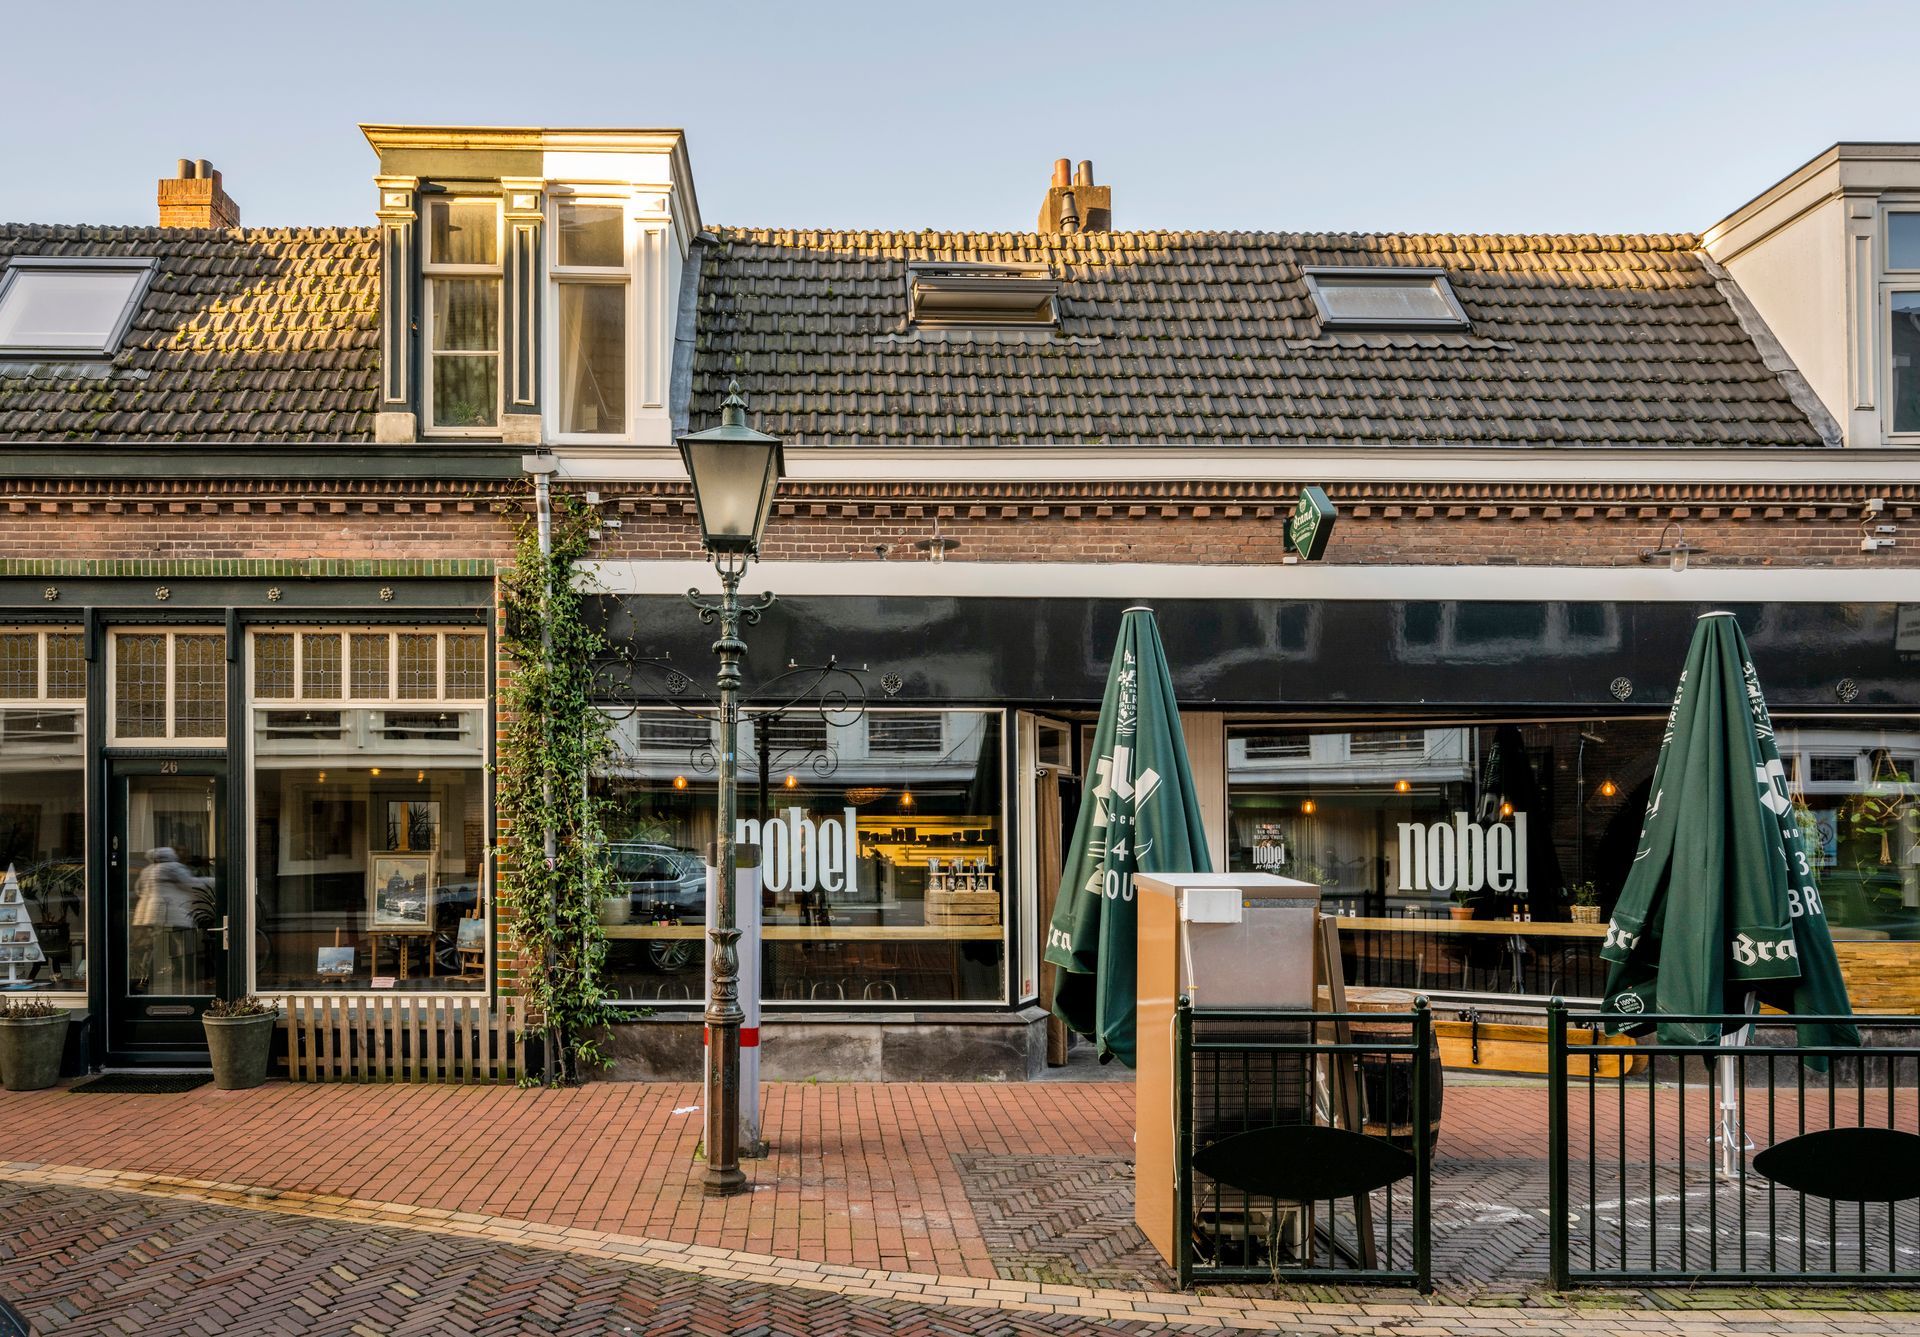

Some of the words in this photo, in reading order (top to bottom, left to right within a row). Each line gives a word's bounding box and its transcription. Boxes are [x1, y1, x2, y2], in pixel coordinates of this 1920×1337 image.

[160, 761, 178, 773] 26
[1110, 837, 1129, 861] 4
[1253, 843, 1284, 864] nobel
[1397, 811, 1528, 893] nobel
[1794, 851, 1810, 876] 3
